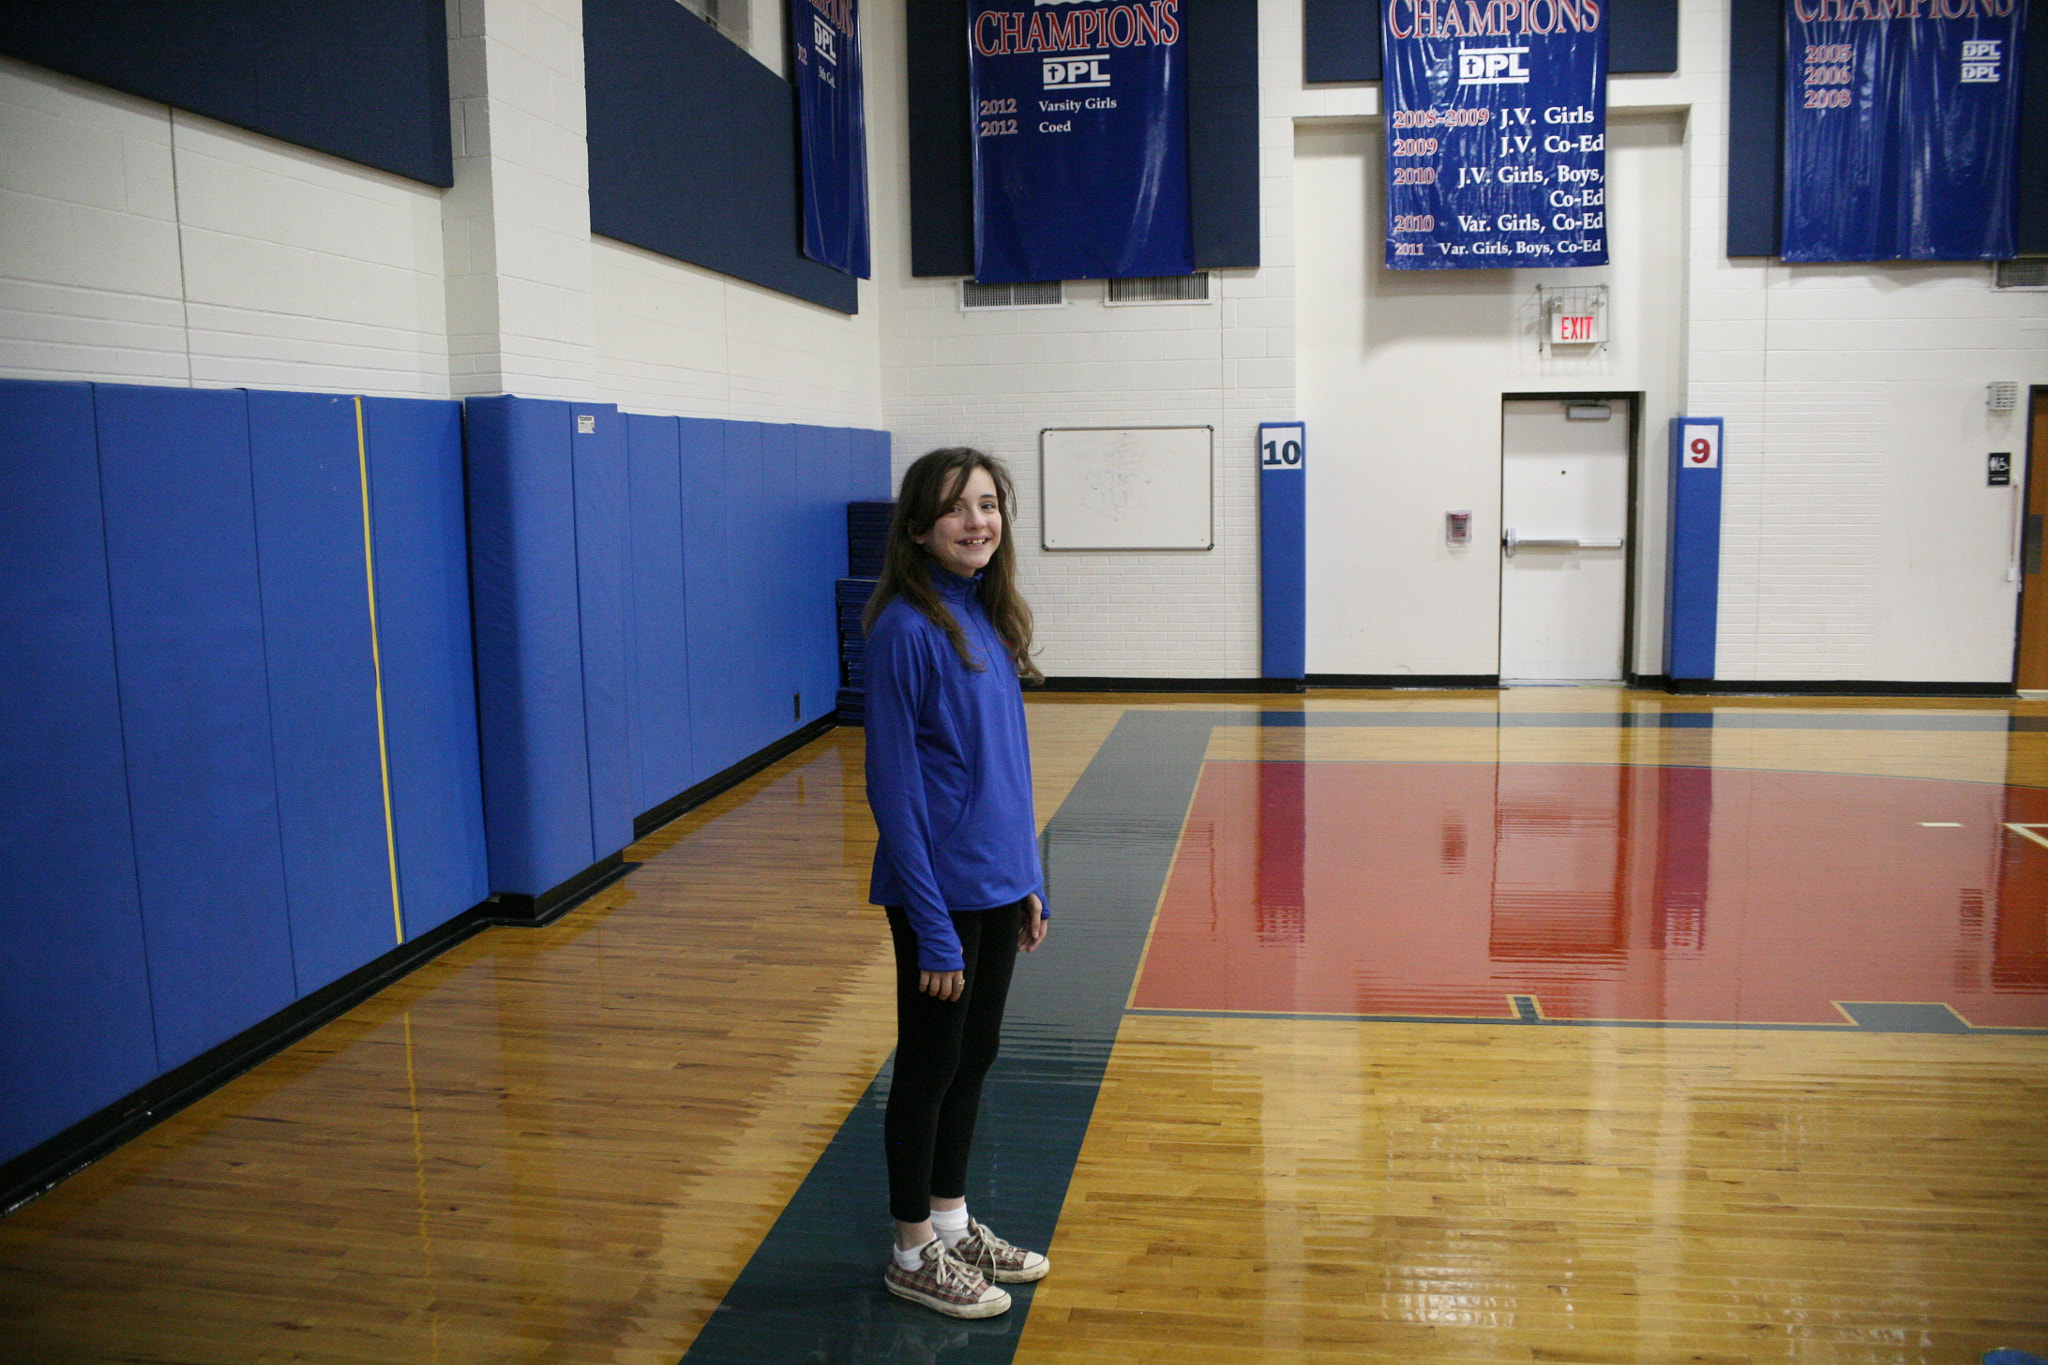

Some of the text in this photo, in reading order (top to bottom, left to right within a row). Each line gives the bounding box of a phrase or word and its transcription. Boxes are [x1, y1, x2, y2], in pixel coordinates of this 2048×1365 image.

[975, 0, 1180, 56] CHAMPIONS
[1389, 0, 1600, 39] CHAMPIONS
[814, 19, 837, 60] DPL
[1962, 43, 2001, 58] DPL
[1804, 44, 1852, 64] 2005
[1043, 60, 1111, 85] DPL
[1459, 53, 1530, 79] DPL
[1804, 65, 1852, 85] 2006
[1961, 65, 2000, 80] DPL
[980, 97, 1117, 116] 2012 Varsity Girls
[1803, 88, 1852, 109] 2008
[980, 119, 1071, 137] 2012 Coed
[1393, 105, 1595, 129] 2008-2009 J.V. Girls
[1393, 134, 1605, 157] 2009 J.V. Co-Ed
[1393, 164, 1605, 189] 2010 J.V. Girls, Boys,
[1550, 188, 1604, 208] Co-Ed
[1394, 213, 1604, 234] 2010 Var. Girls, Co-Ed
[1394, 239, 1602, 257] 2011 Var. Girls, Boys, Co-Ed
[1562, 316, 1594, 340] EXIT
[1263, 440, 1302, 465] 10
[1691, 438, 1711, 464] 9
